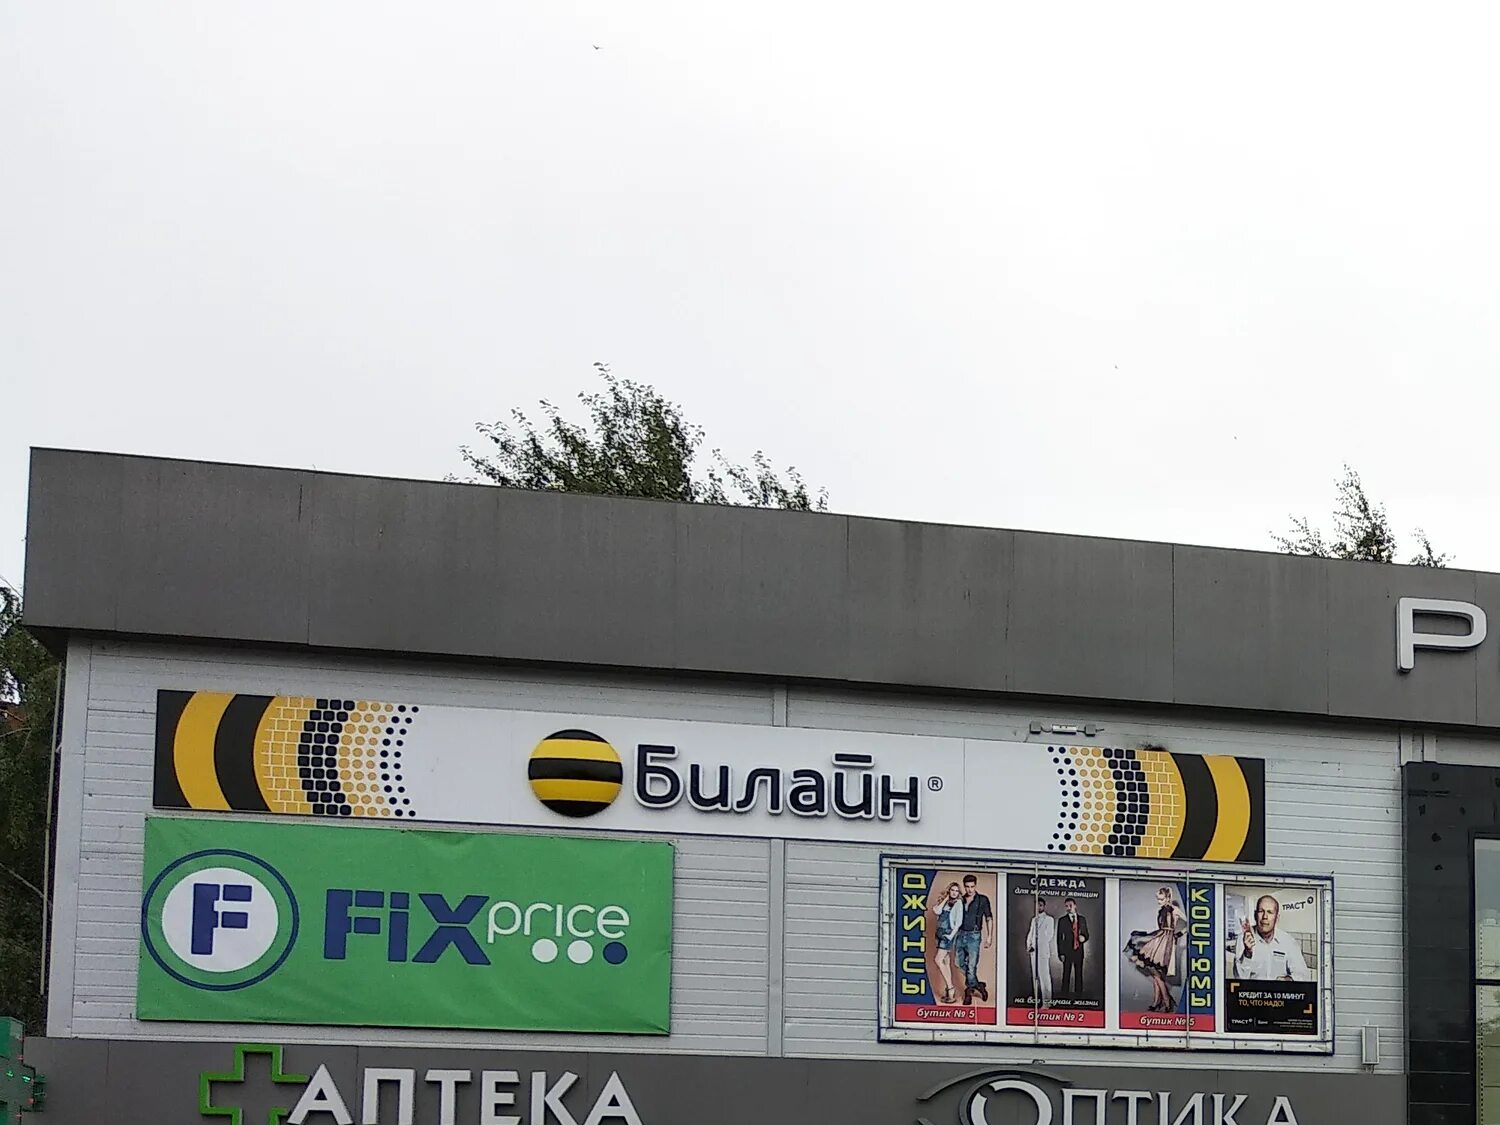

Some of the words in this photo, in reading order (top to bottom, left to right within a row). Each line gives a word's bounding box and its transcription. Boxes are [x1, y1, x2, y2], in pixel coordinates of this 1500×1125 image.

[1030, 877, 1087, 889] ОДЕЖДА
[487, 900, 631, 944] price
[902, 872, 927, 996] ДЖИНСЫ
[1190, 887, 1212, 1009] КОСТЮМЫ
[1238, 991, 1263, 1000] КРЕДИТ
[1264, 992, 1272, 1000] ЗА
[1282, 993, 1306, 1001] МИНУТ
[916, 1007, 951, 1019] бутик
[968, 1009, 976, 1019] 5
[1078, 1013, 1085, 1023] 2
[1139, 1016, 1172, 1027] бутик
